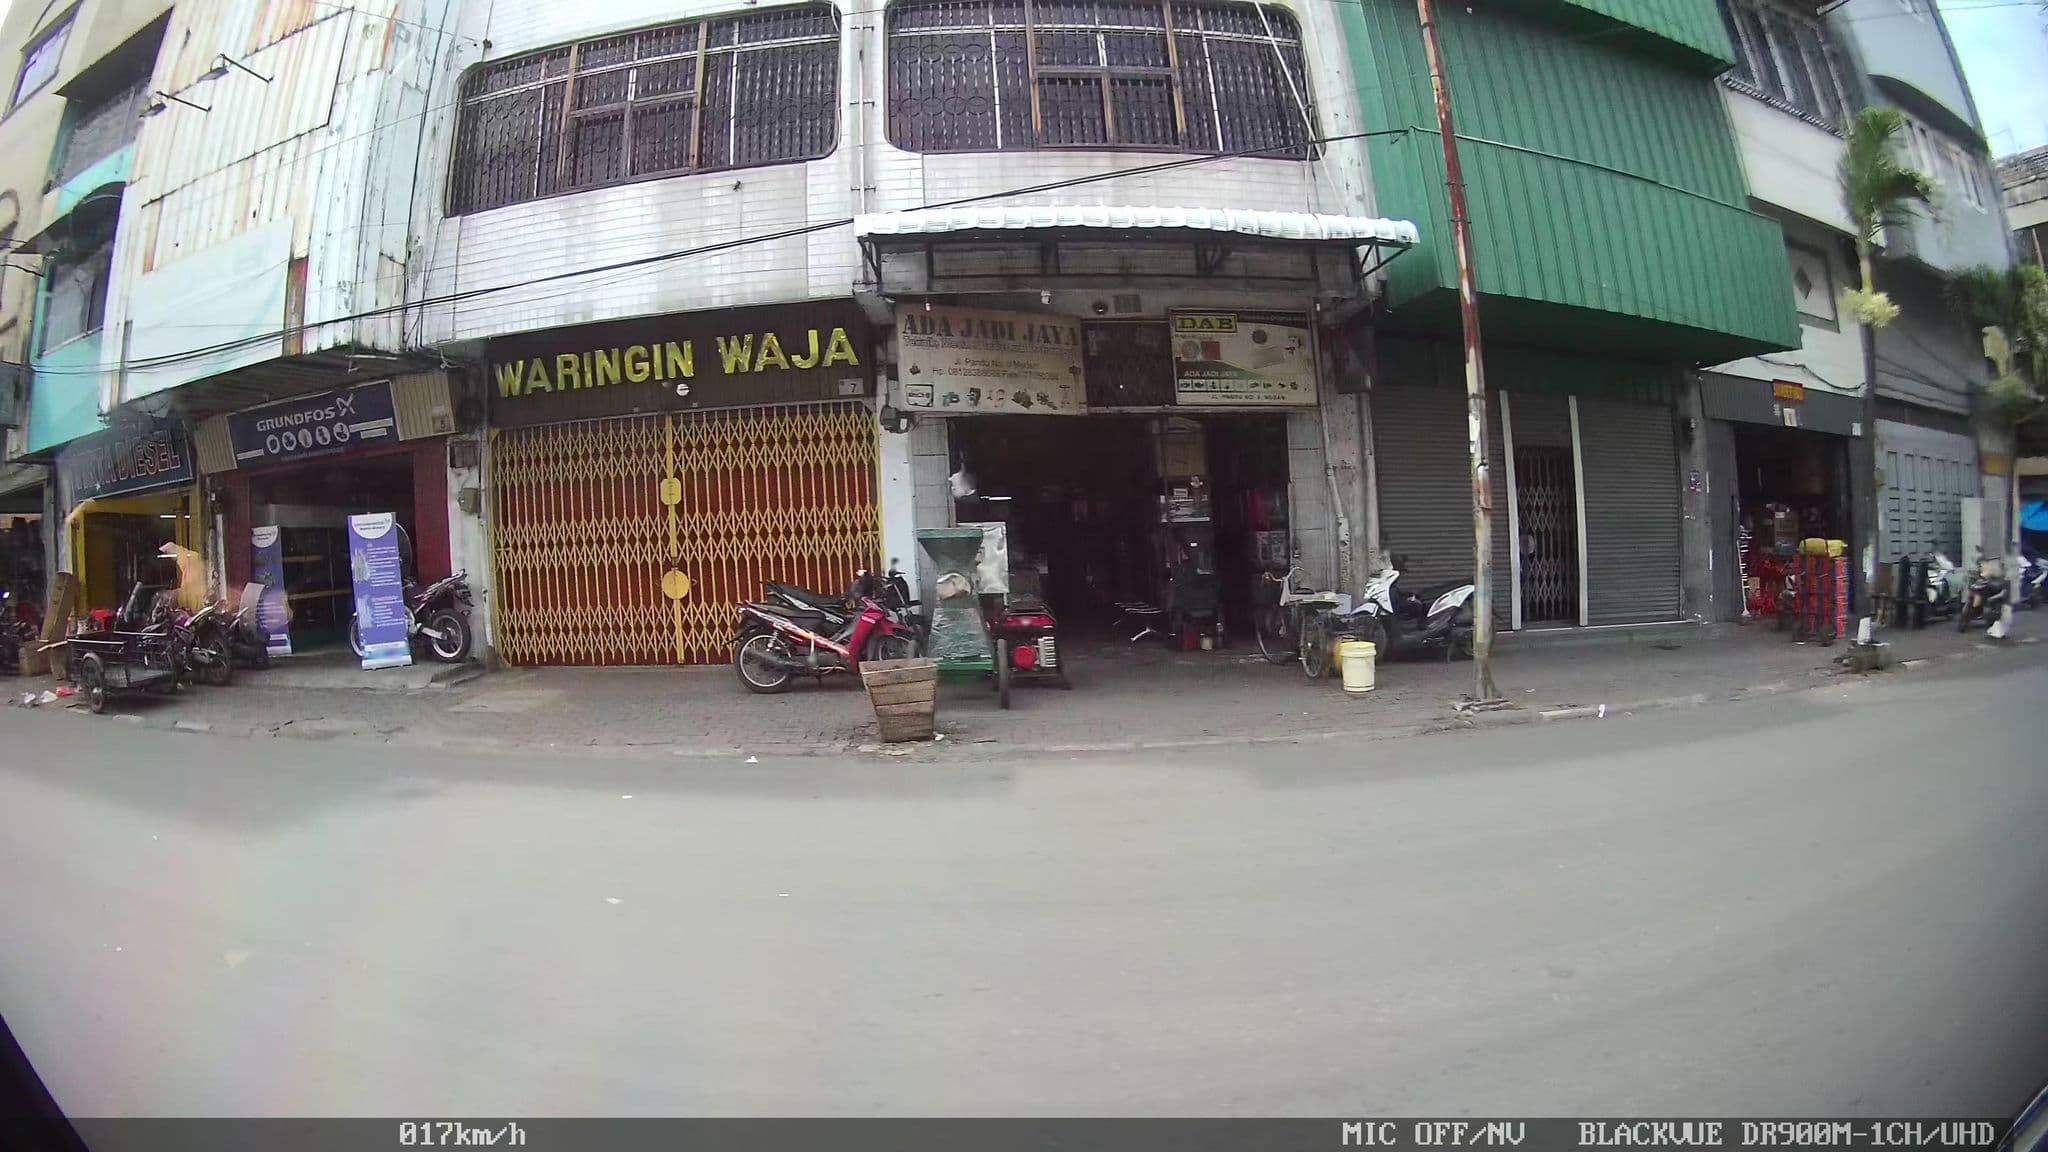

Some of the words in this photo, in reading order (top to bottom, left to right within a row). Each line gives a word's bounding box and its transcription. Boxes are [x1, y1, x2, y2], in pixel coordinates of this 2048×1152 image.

[902, 313, 954, 336] ADA
[959, 318, 1016, 342] JADI
[1022, 323, 1080, 346] JAYA
[1180, 317, 1234, 330] DAB
[495, 340, 695, 397] WARINGIN
[717, 328, 859, 374] WAJA
[850, 382, 857, 393] 7
[256, 406, 336, 432] GRUNDFOS
[116, 430, 182, 481] DIESEL
